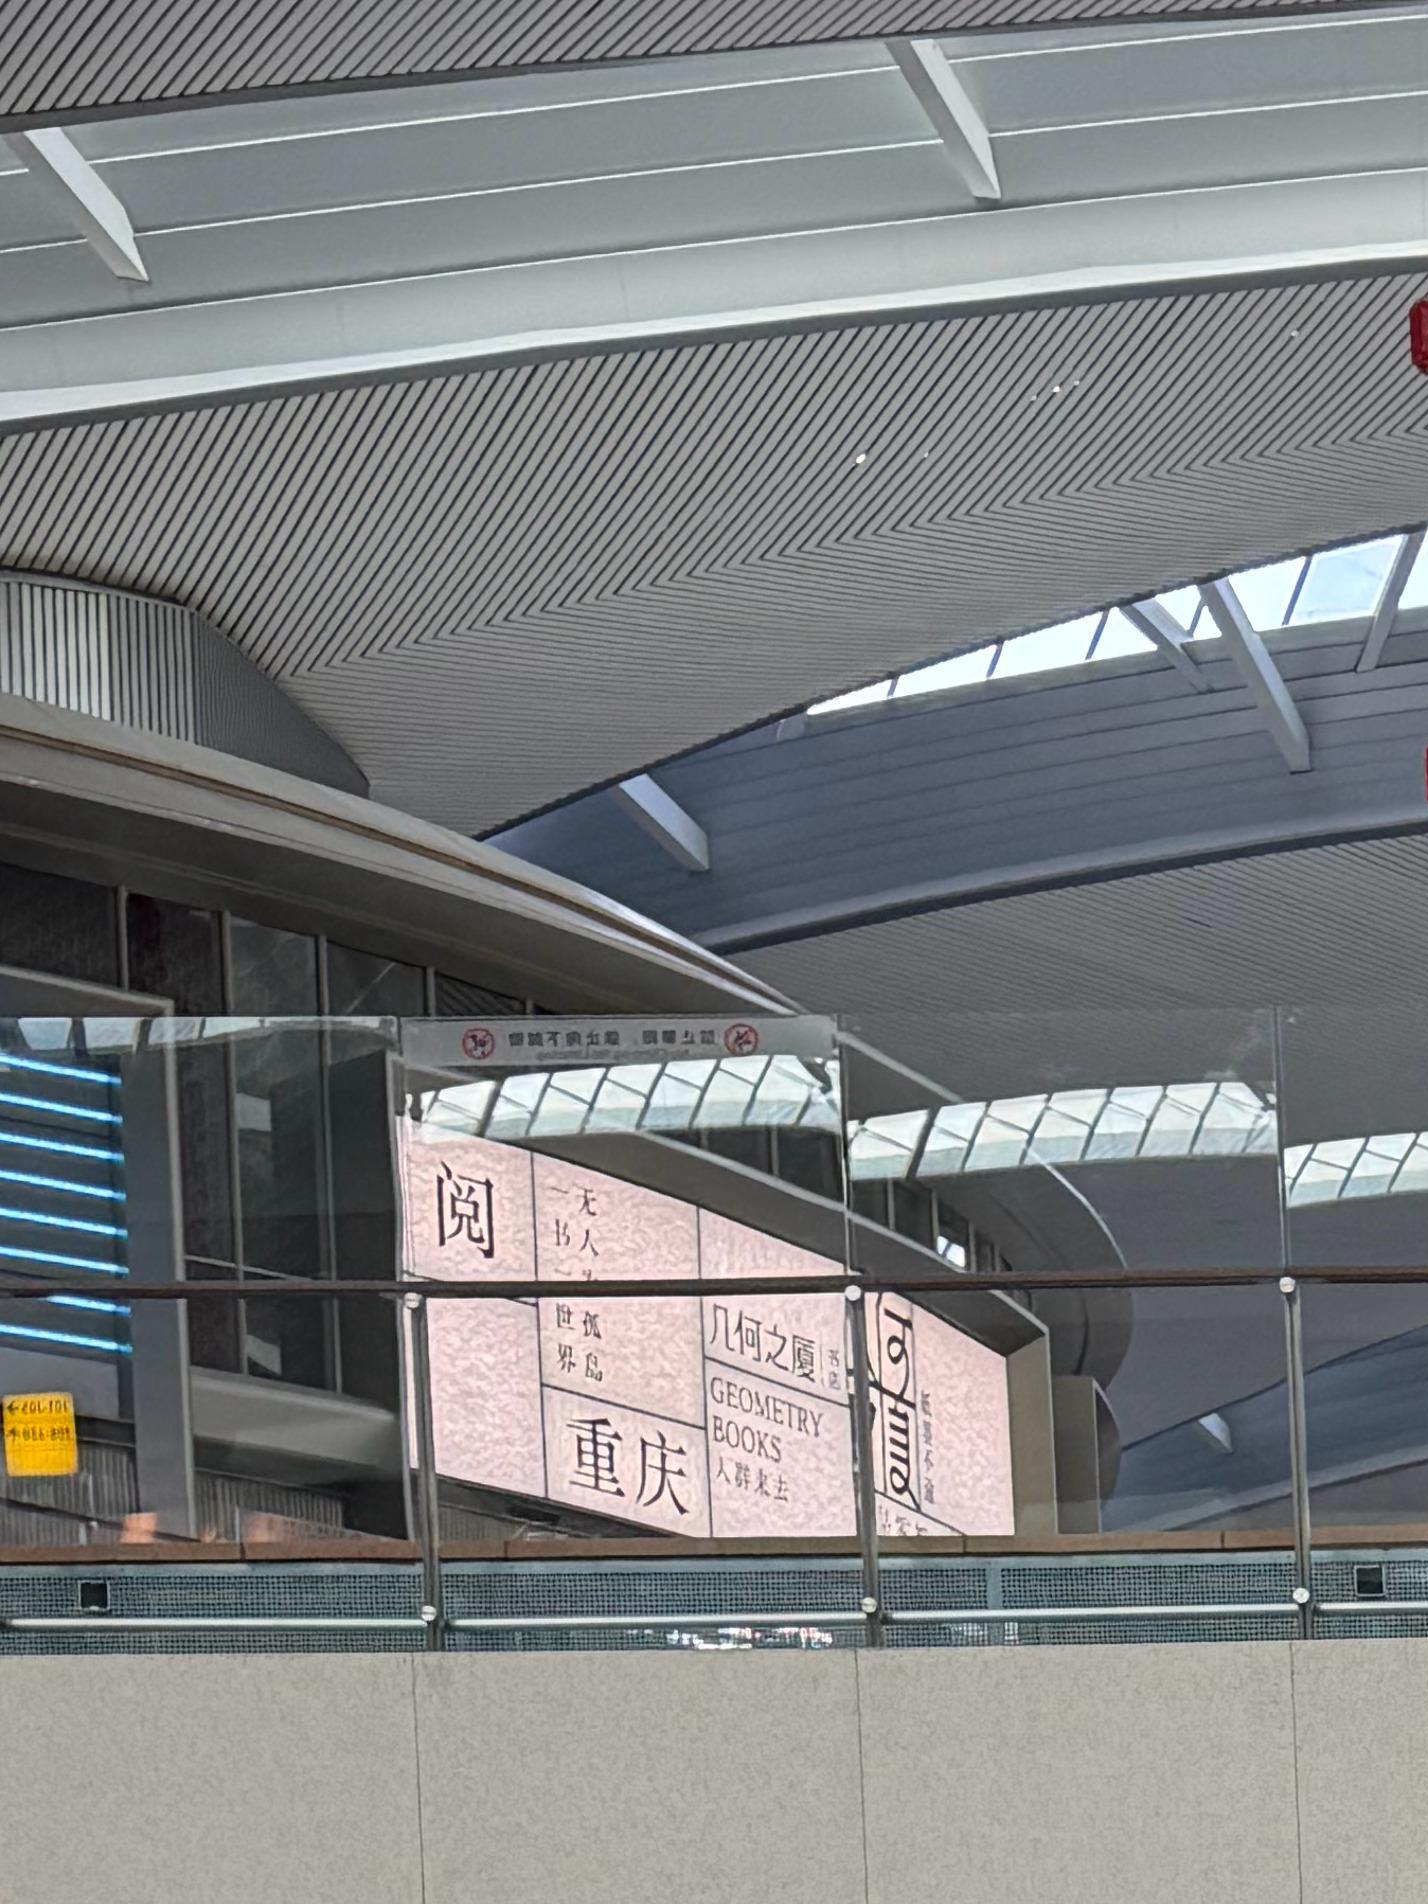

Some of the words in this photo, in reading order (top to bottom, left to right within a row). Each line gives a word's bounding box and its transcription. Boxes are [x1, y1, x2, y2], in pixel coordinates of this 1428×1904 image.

[437, 1161, 496, 1259] 阅
[711, 1304, 815, 1383] 几何之厦
[711, 1376, 823, 1438] GEOMETRY
[713, 1415, 782, 1463] BOOKS
[566, 1417, 690, 1516] 重庆
